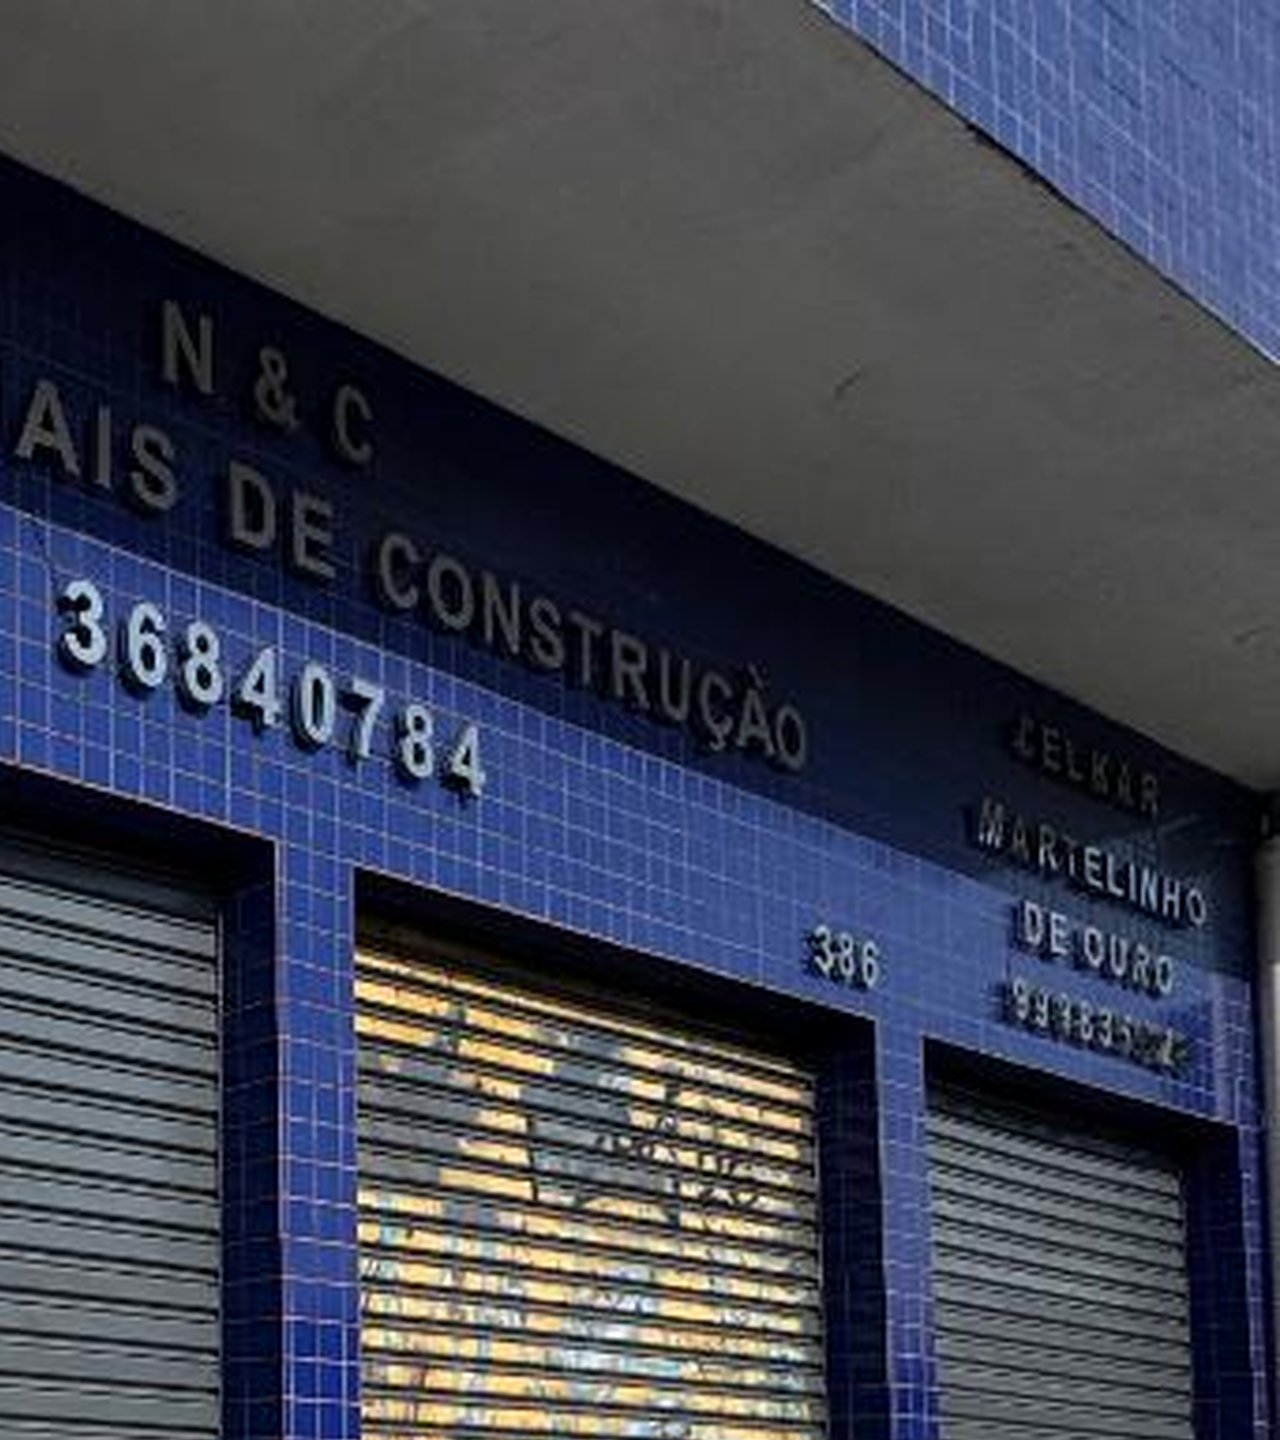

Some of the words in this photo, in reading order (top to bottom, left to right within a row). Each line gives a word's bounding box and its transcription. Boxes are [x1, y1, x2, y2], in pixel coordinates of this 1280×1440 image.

[161, 298, 216, 396] N
[253, 344, 302, 431] &
[332, 383, 374, 465] C
[228, 459, 337, 580] DE
[60, 578, 487, 799] 36840784
[979, 796, 1208, 926] MARTELINHO
[813, 924, 880, 988] 386
[1022, 899, 1069, 956] DE
[1082, 926, 1174, 994] OURO
